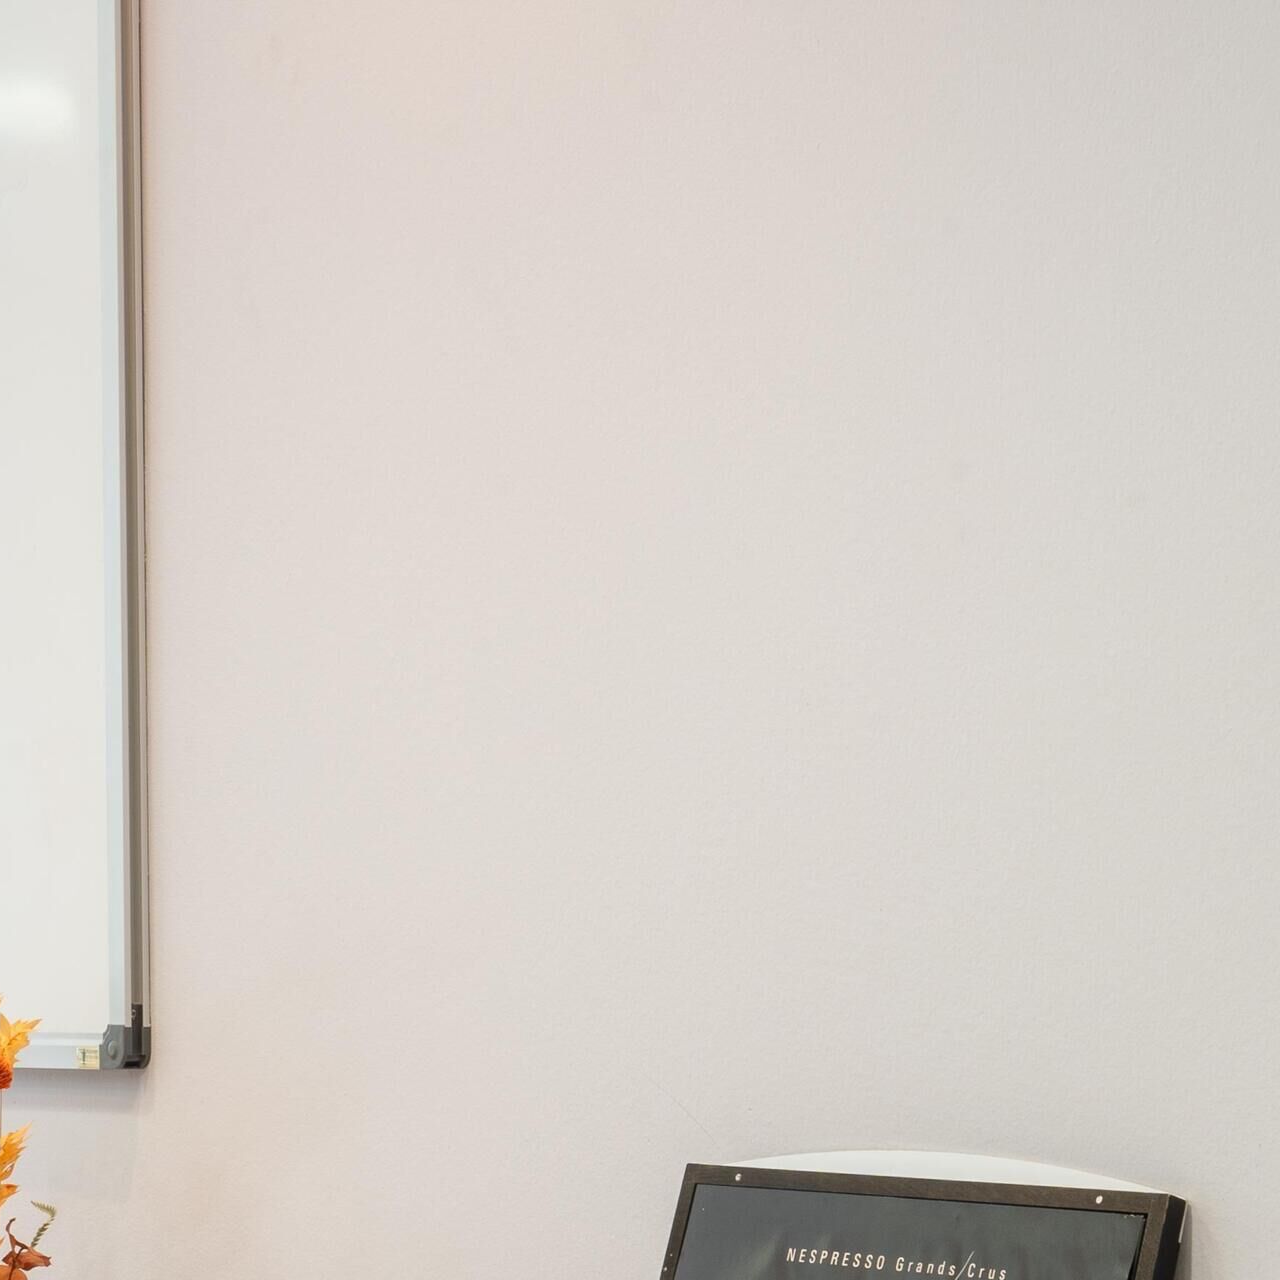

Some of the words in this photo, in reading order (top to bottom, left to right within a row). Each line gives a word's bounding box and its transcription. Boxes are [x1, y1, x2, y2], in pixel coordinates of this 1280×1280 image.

[786, 1248, 885, 1270] NESPRESSO
[895, 1257, 956, 1277] Grands
[967, 1263, 1007, 1280] Crus
